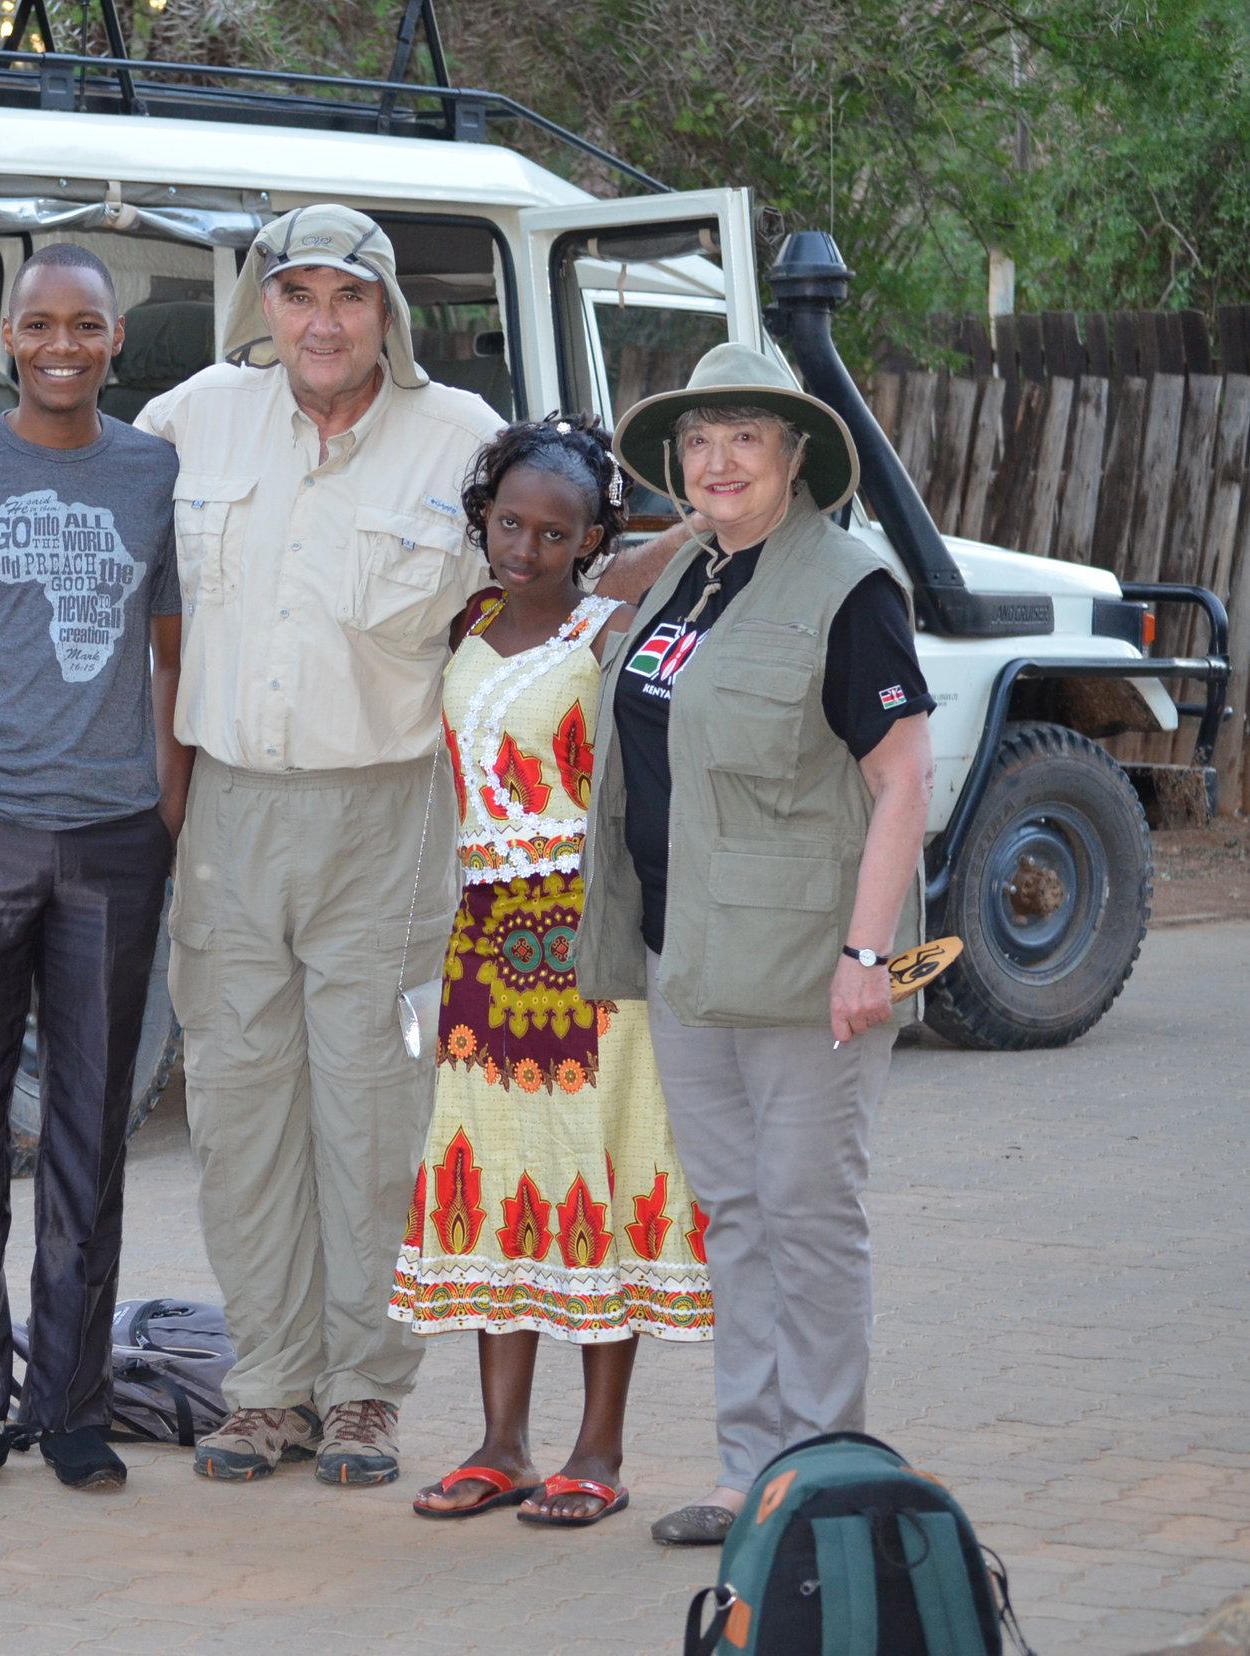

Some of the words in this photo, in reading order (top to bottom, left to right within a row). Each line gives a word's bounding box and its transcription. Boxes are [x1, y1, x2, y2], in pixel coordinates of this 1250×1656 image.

[26, 496, 52, 505] said
[34, 512, 59, 537] into
[64, 513, 109, 530] ALL
[32, 538, 60, 549] THE
[62, 530, 115, 553] WORLD
[25, 553, 97, 576] PREACH
[99, 557, 134, 585] the
[51, 576, 98, 592] GOOD
[57, 594, 98, 624] news
[99, 596, 110, 609] TO
[97, 607, 121, 629] all
[59, 626, 110, 645] creation
[64, 648, 100, 661] Mark
[642, 683, 671, 700] KENYA
